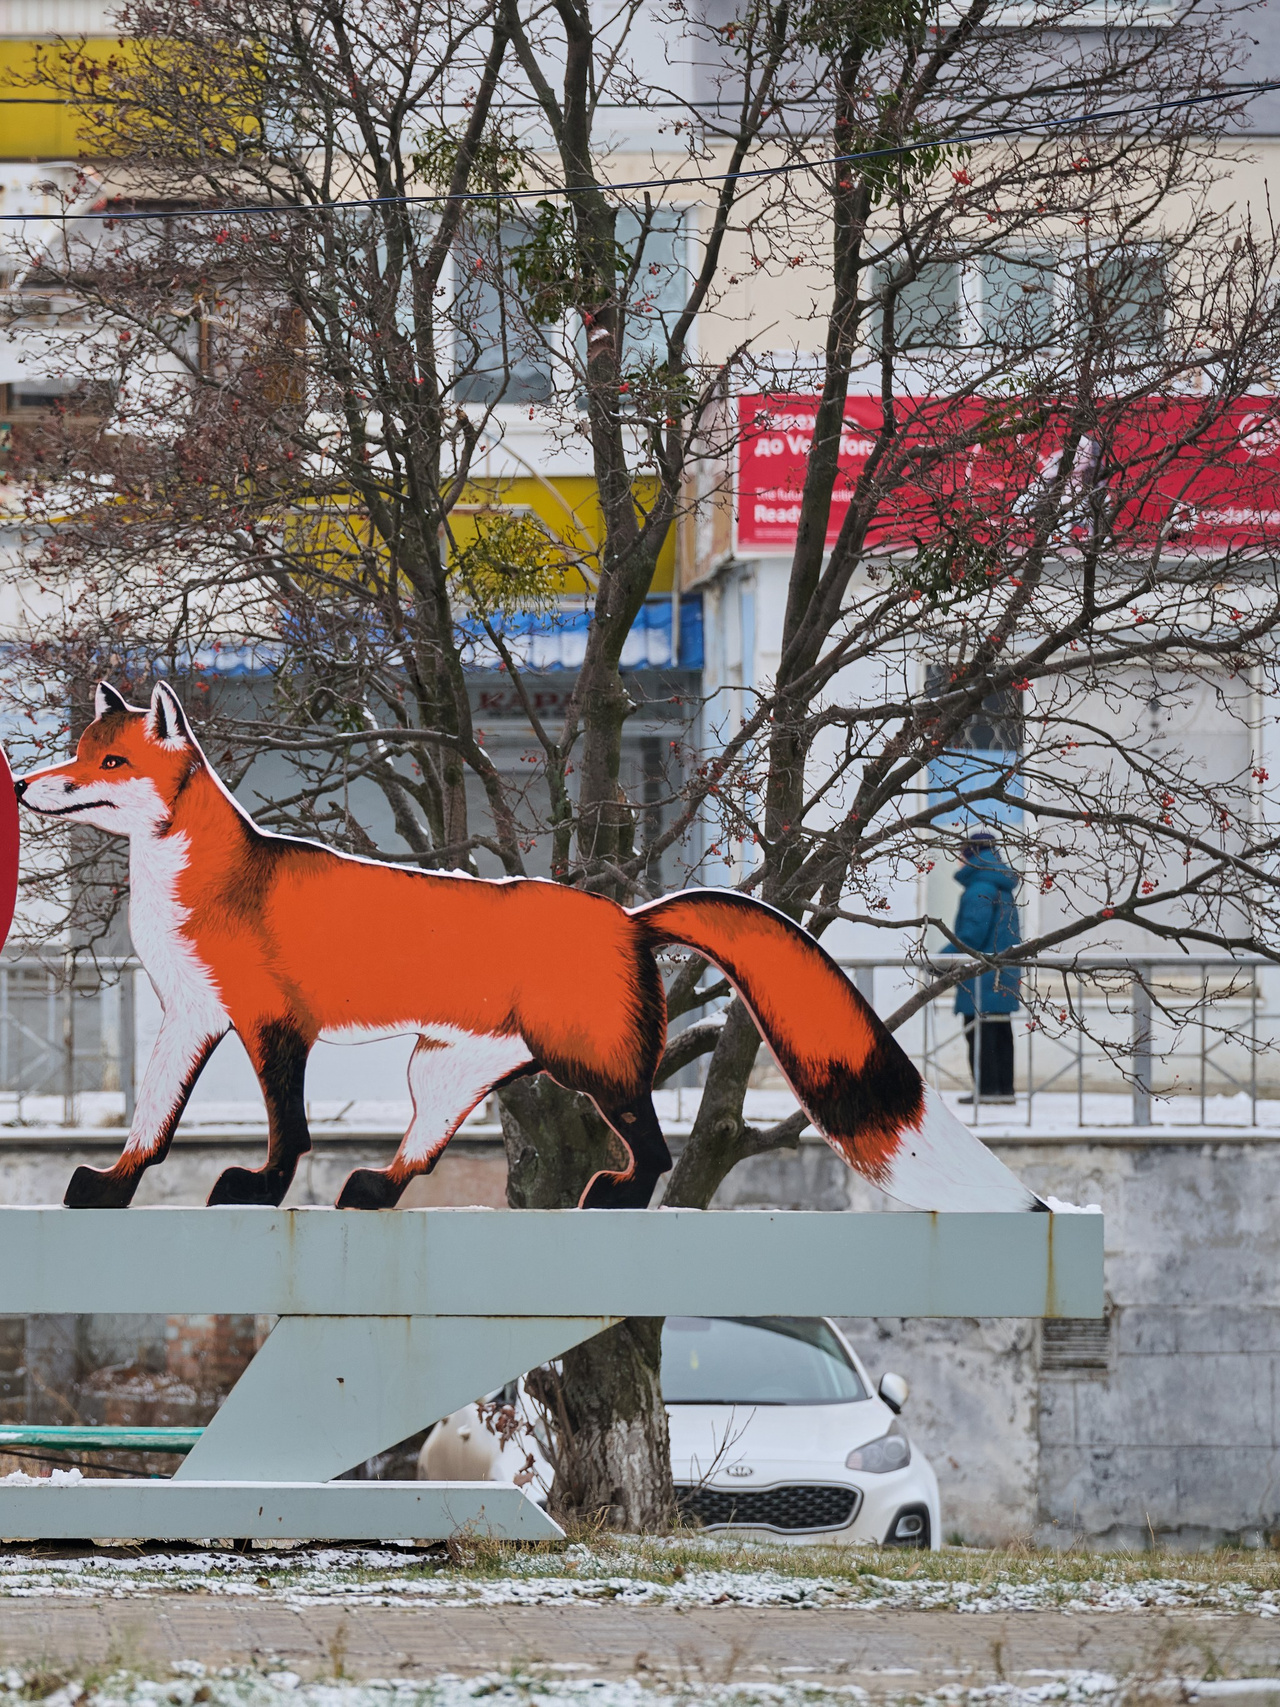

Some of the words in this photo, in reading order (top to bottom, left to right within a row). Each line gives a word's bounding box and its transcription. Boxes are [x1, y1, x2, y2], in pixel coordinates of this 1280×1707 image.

[754, 438, 784, 457] до
[786, 434, 877, 456] Vofone
[726, 1464, 753, 1477] KIA
